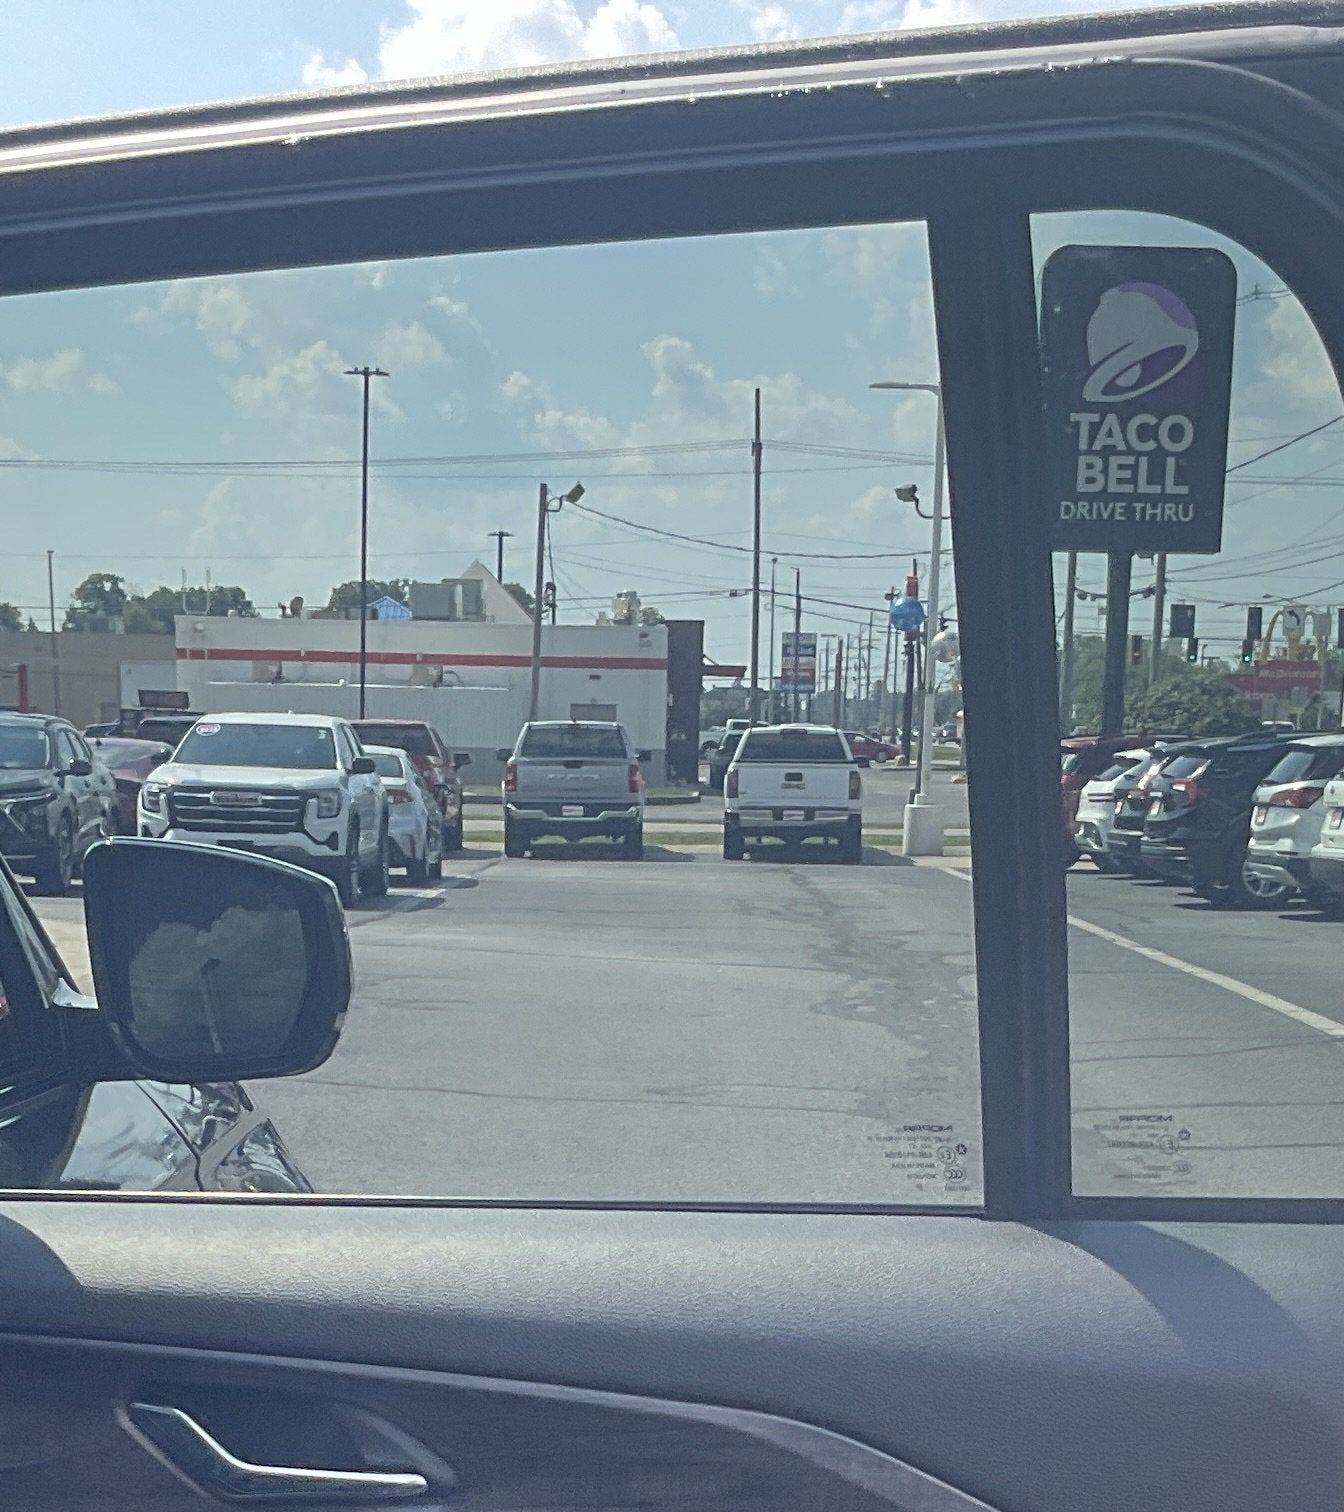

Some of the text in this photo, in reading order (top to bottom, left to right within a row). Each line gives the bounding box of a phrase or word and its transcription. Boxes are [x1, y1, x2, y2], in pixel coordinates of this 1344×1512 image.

[1070, 412, 1194, 453] TACO
[1076, 456, 1190, 495] BELL
[1060, 501, 1195, 522] DRIVE THRU
